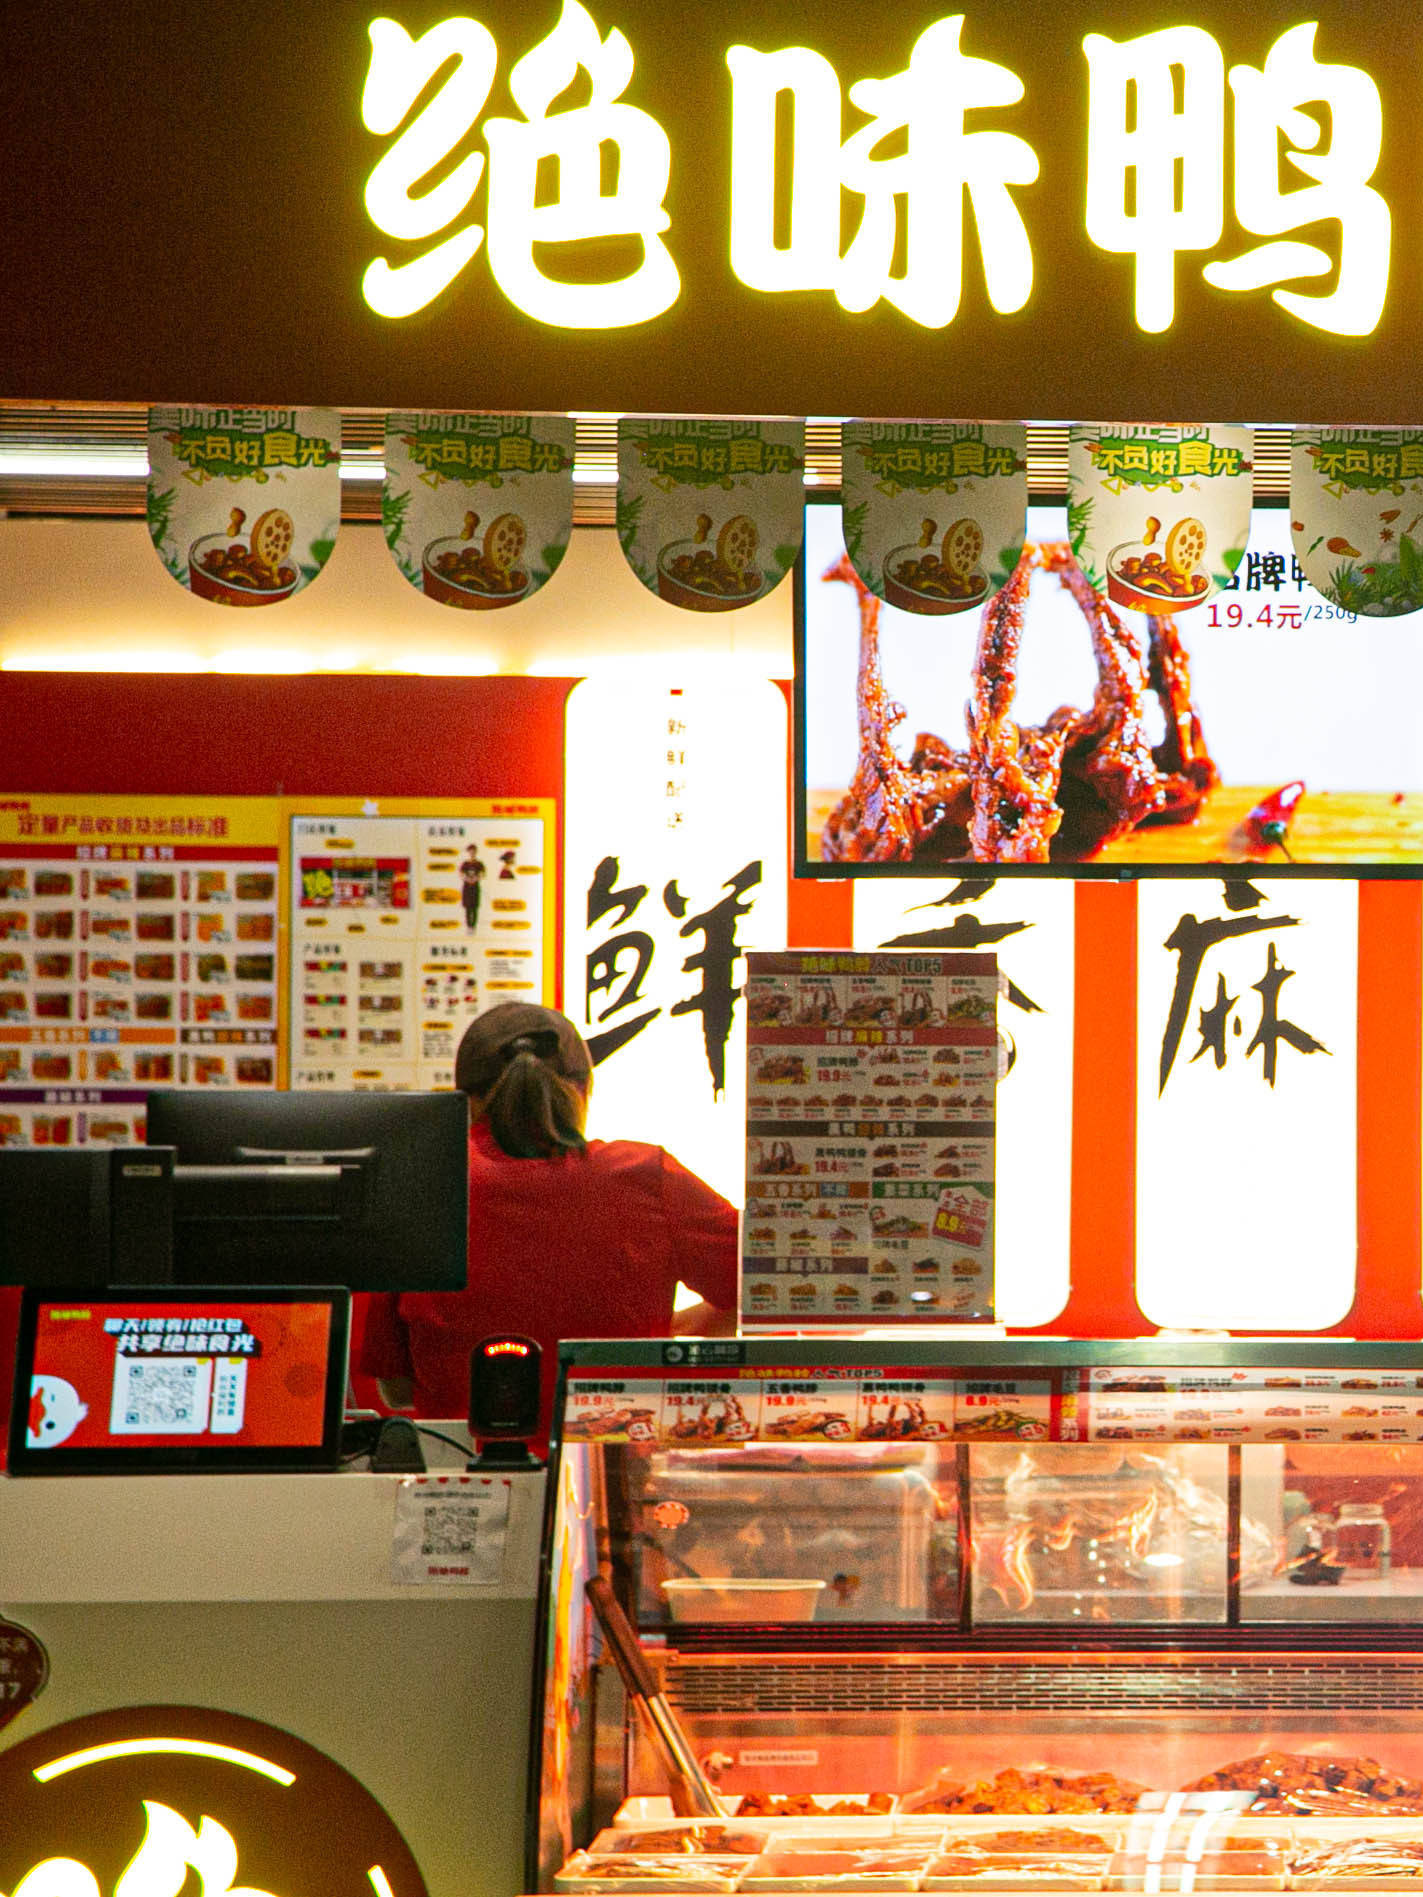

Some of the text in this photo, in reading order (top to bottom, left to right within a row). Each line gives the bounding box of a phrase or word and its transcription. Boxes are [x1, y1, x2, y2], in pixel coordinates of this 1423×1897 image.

[181, 433, 326, 466] 不负好食光
[418, 436, 564, 471] 不负好食光
[648, 439, 793, 473] 不负好食光
[873, 442, 1014, 476] 不负好食光
[1099, 443, 1239, 476] 不负好食光
[586, 855, 762, 1102] 鲜
[1159, 880, 1333, 1098] 麻
